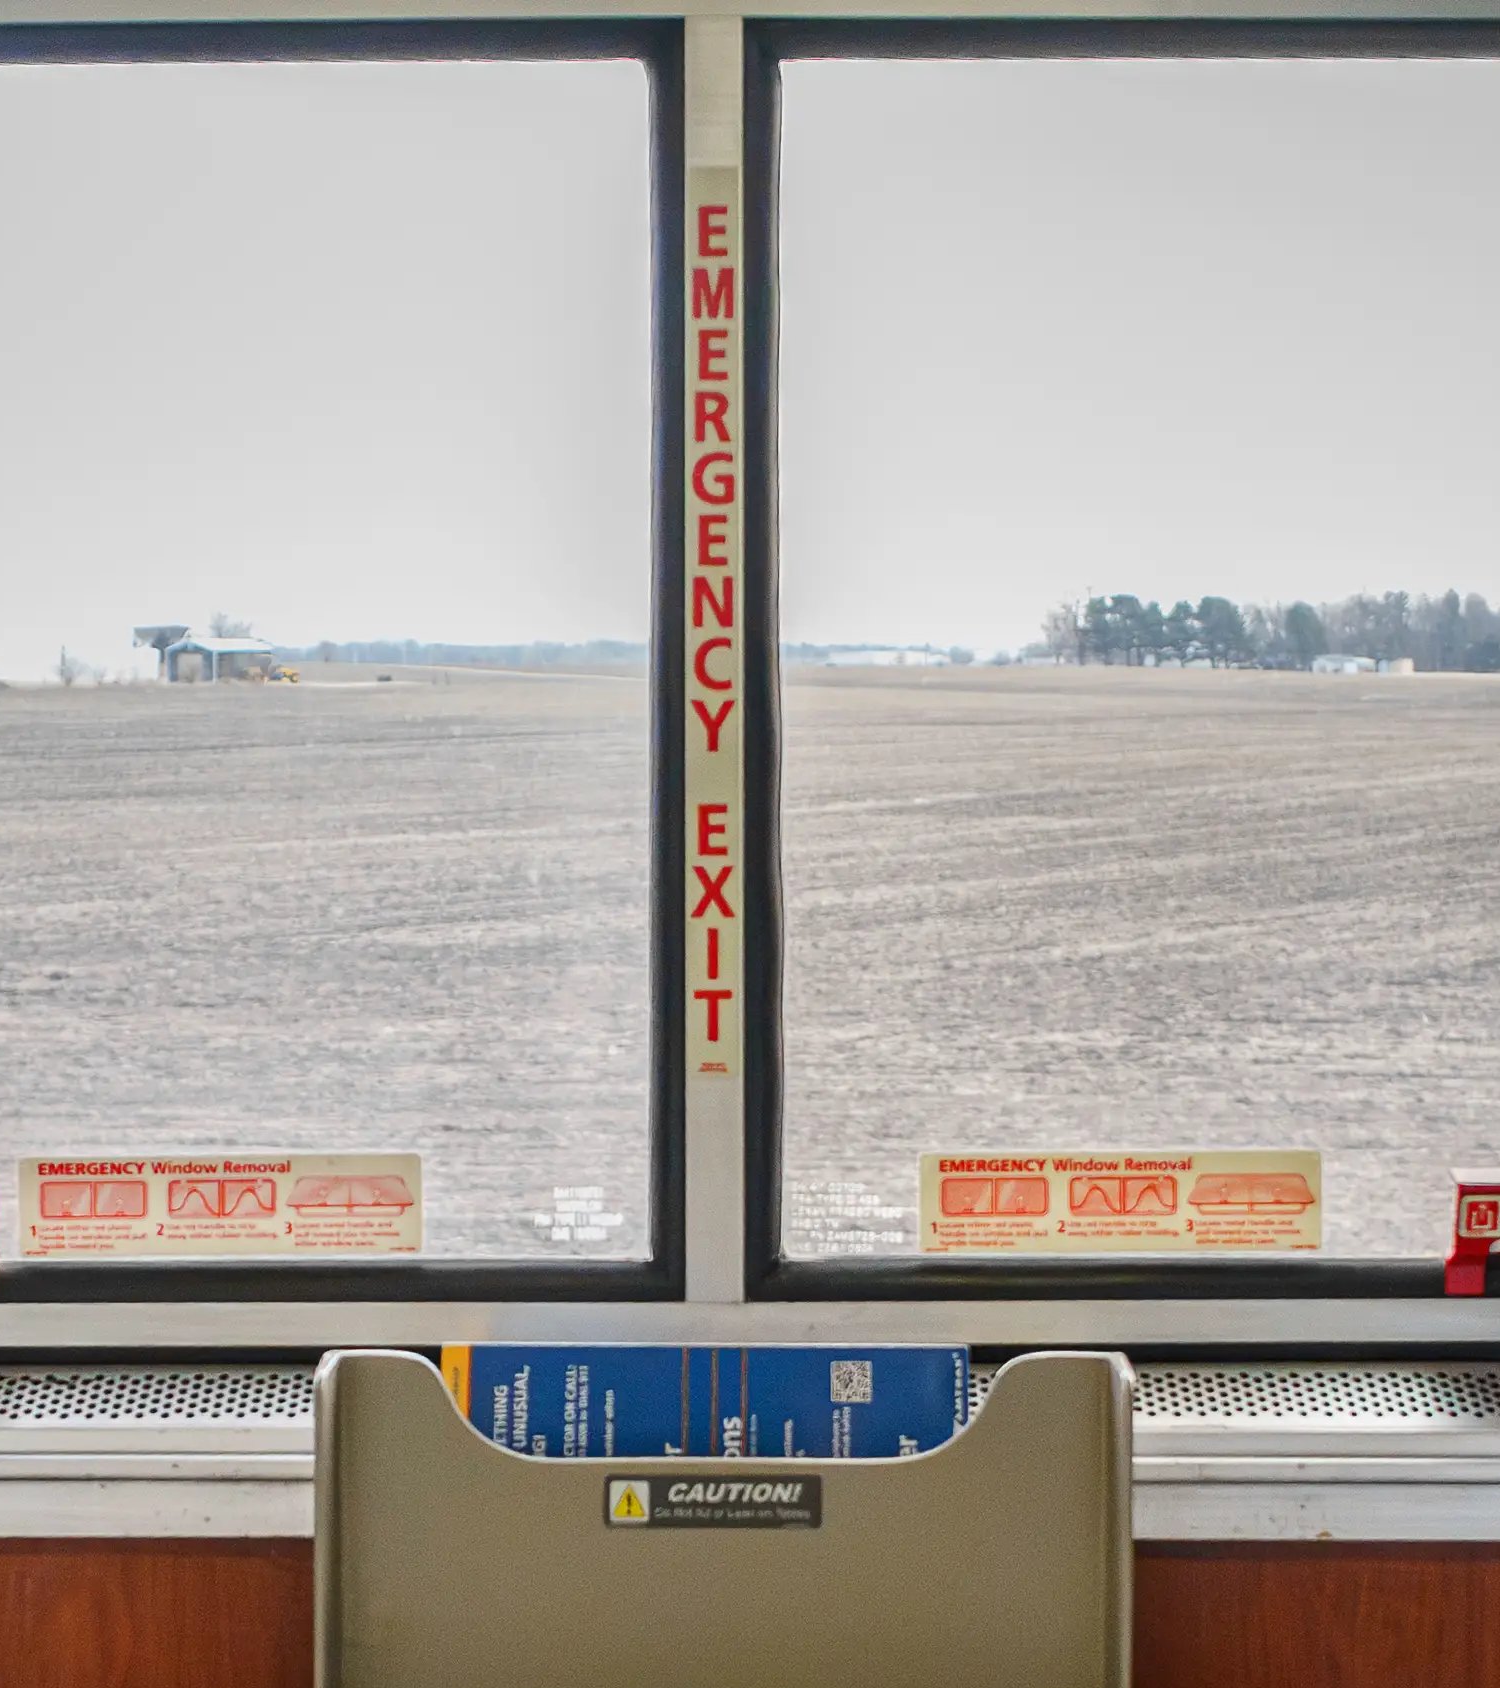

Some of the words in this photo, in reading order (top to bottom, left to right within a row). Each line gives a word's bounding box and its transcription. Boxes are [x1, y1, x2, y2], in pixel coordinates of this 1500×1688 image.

[691, 203, 736, 752] EMERGENCY
[690, 804, 736, 1042] EXIT
[37, 1162, 146, 1176] EMERGENCY
[151, 1161, 218, 1175] Window
[223, 1160, 292, 1174] Removal
[939, 1159, 1048, 1173] EMERGENCY
[1052, 1158, 1119, 1172] Window
[1124, 1156, 1194, 1171] Removal
[156, 1223, 165, 1236] 2
[284, 1221, 293, 1235] 3
[1056, 1220, 1066, 1233] 2
[1185, 1219, 1194, 1232] 3
[667, 1482, 804, 1504] CAUTION!
